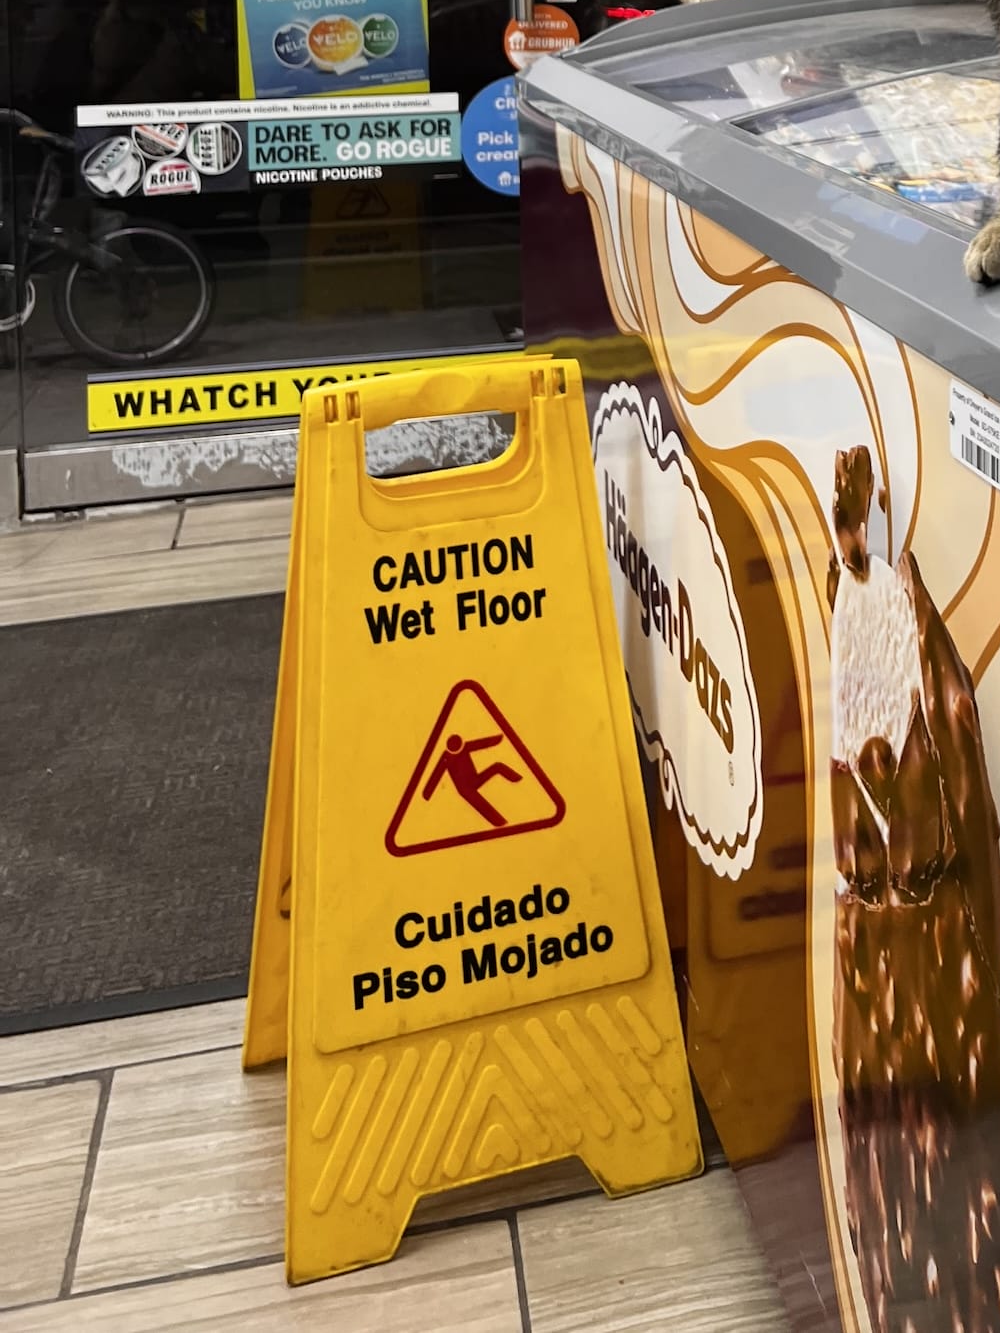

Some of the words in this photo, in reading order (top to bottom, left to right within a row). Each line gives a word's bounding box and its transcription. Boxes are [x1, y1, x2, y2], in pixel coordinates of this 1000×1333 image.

[313, 31, 358, 46] VELO
[365, 30, 395, 41] VELO
[156, 107, 176, 117] This
[178, 106, 212, 118] product
[214, 106, 251, 116] contains
[293, 102, 328, 112] Nicotine
[352, 100, 390, 109] addictive
[255, 124, 312, 144] DARE
[321, 123, 349, 141] TO
[359, 120, 401, 139] ASK
[410, 118, 451, 138] FOR
[478, 132, 513, 146] Pick
[255, 144, 328, 164] MORE.
[336, 141, 371, 161] GO
[376, 137, 452, 160] ROGUE
[151, 170, 192, 186] ROGUE
[256, 168, 318, 185] NICOTINE
[322, 166, 383, 182] POUCHES
[114, 381, 276, 418] WHATCH
[372, 534, 534, 593] CAUTION
[364, 601, 435, 645] Wet
[457, 588, 546, 630] Floor
[604, 467, 734, 755] Häagen-Dazs
[395, 884, 570, 949] Cuidado
[353, 967, 446, 1010] Piso
[462, 921, 614, 985] Mojado
